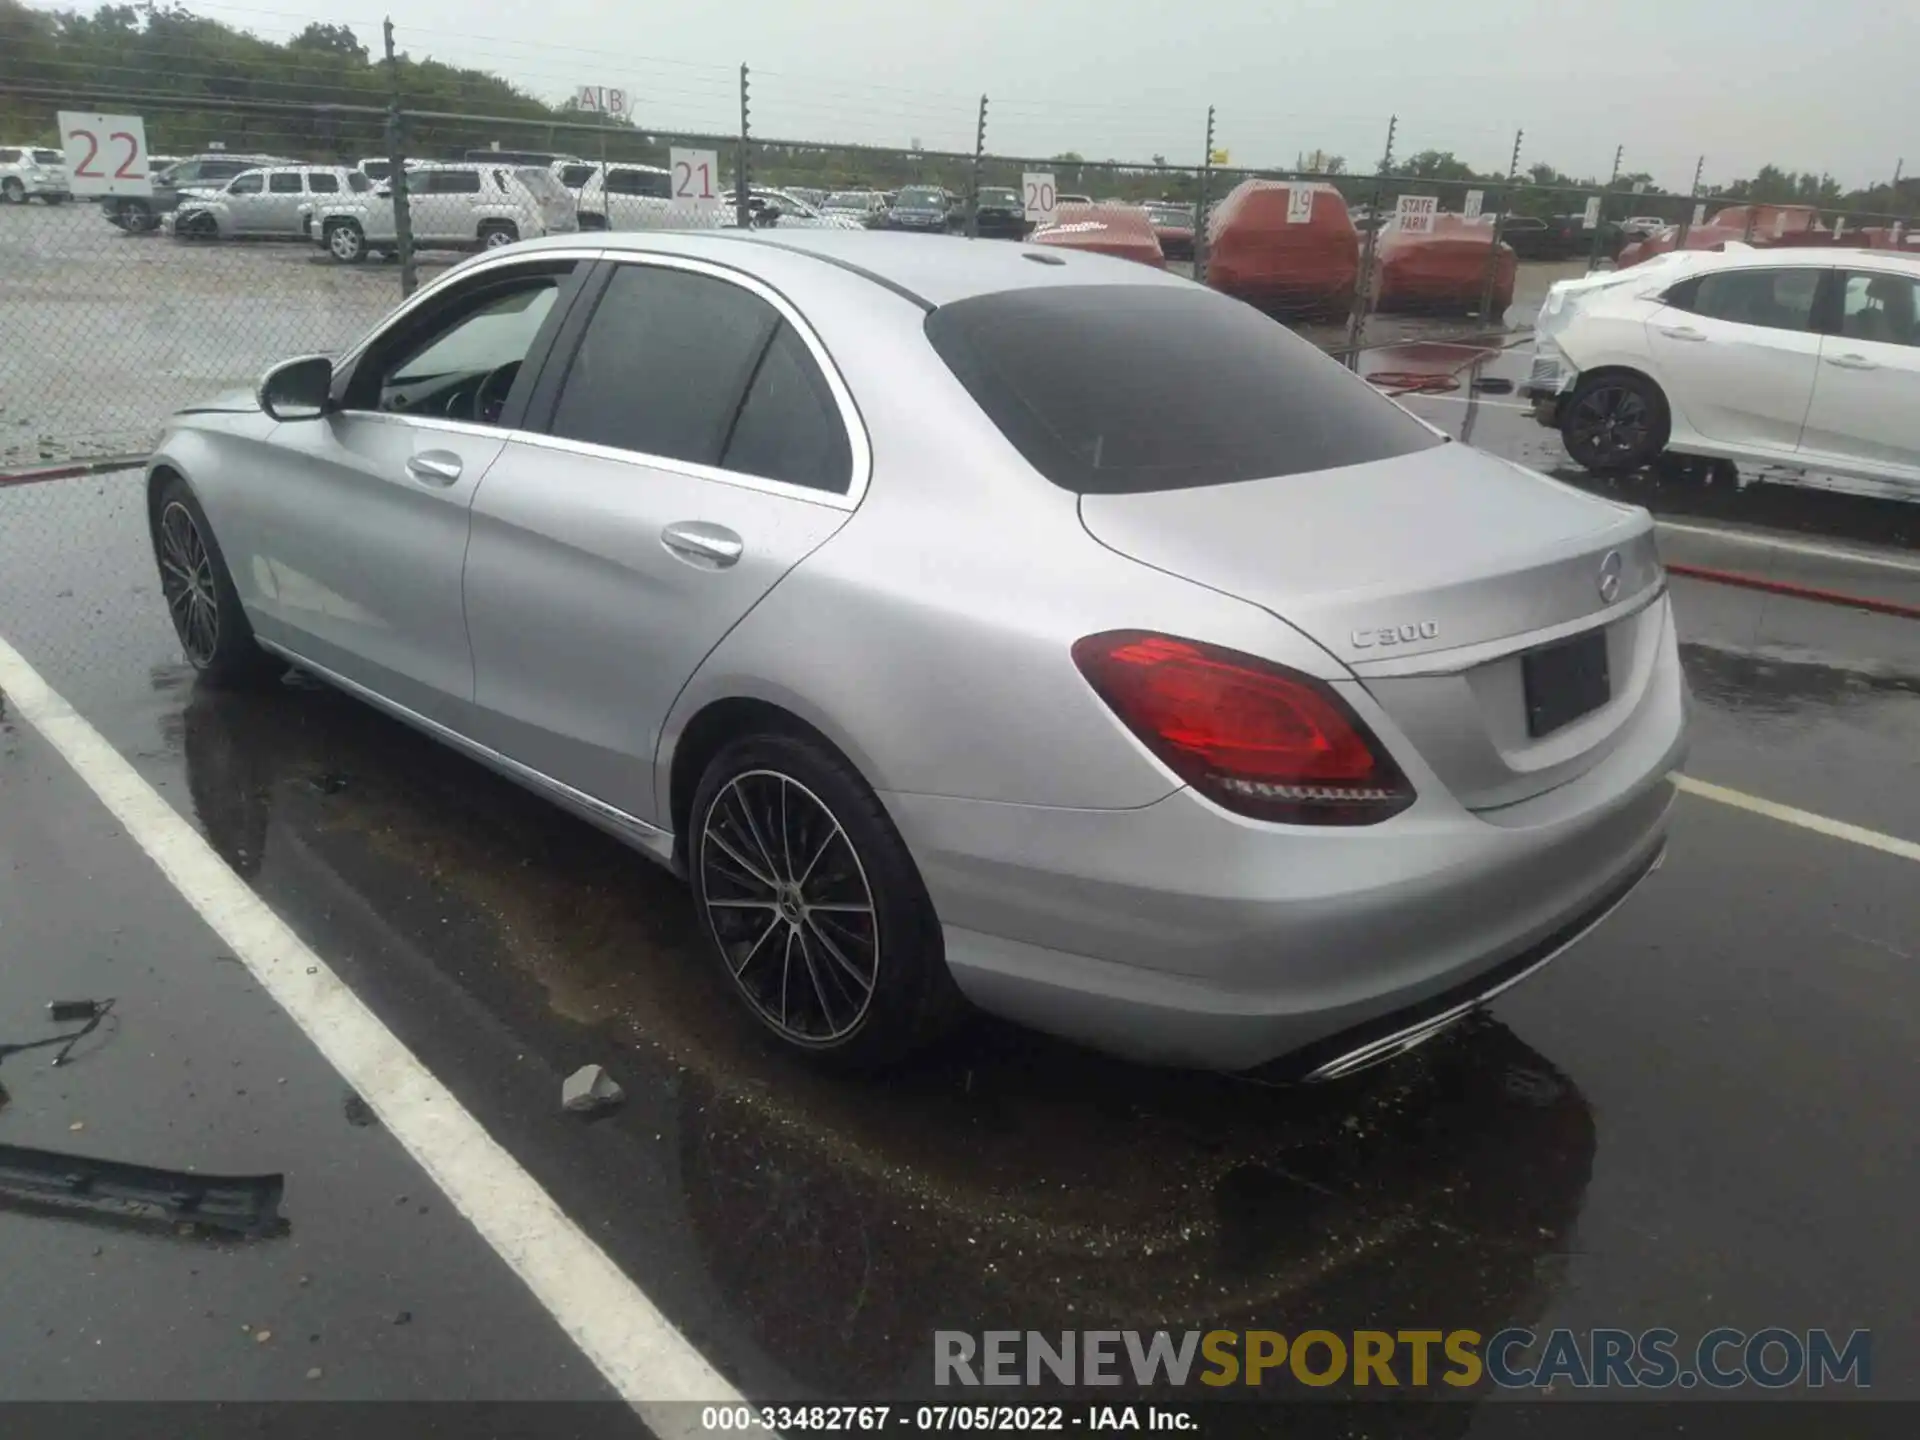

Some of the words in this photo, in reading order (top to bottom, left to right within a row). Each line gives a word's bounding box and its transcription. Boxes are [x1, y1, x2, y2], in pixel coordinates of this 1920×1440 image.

[580, 87, 597, 110] A
[609, 89, 623, 112] B
[68, 128, 145, 179] 22
[675, 161, 715, 199] 21
[1026, 182, 1054, 212] 20
[1290, 189, 1311, 215] 19
[1401, 198, 1433, 214] STATE
[1400, 215, 1428, 231] FARM
